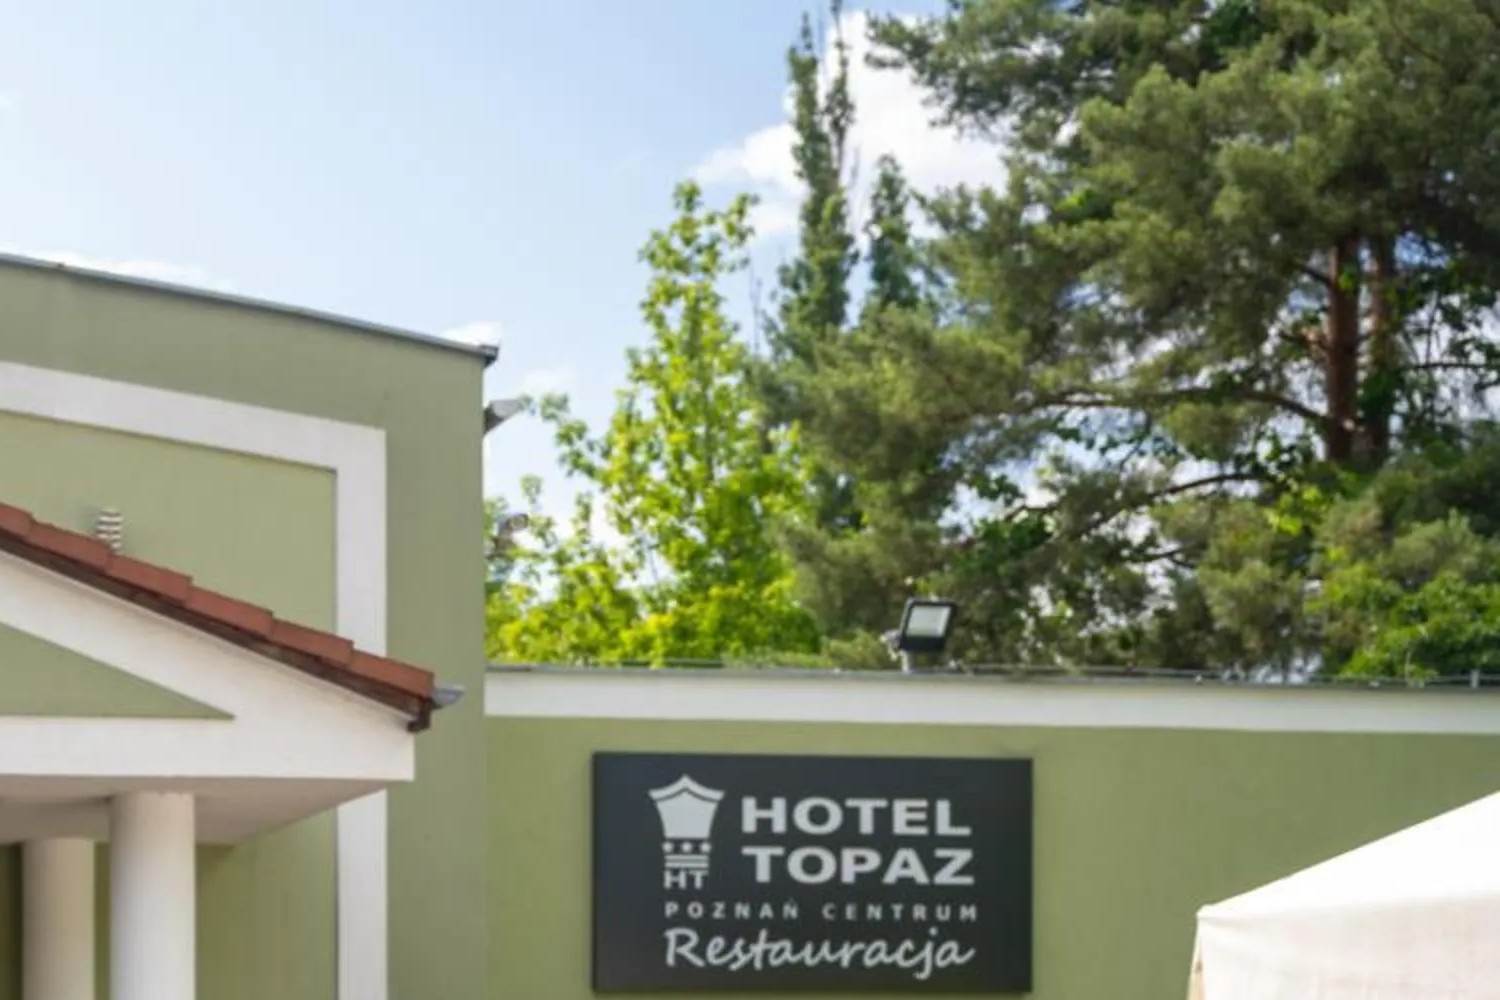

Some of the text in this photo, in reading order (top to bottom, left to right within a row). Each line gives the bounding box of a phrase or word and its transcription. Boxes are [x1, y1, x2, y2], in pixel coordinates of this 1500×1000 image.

[741, 796, 972, 836] HOTEL
[663, 870, 709, 889] HT
[741, 845, 975, 885] TOPAZ
[821, 903, 977, 922] CENTRUM
[663, 926, 975, 980] Restauracja
